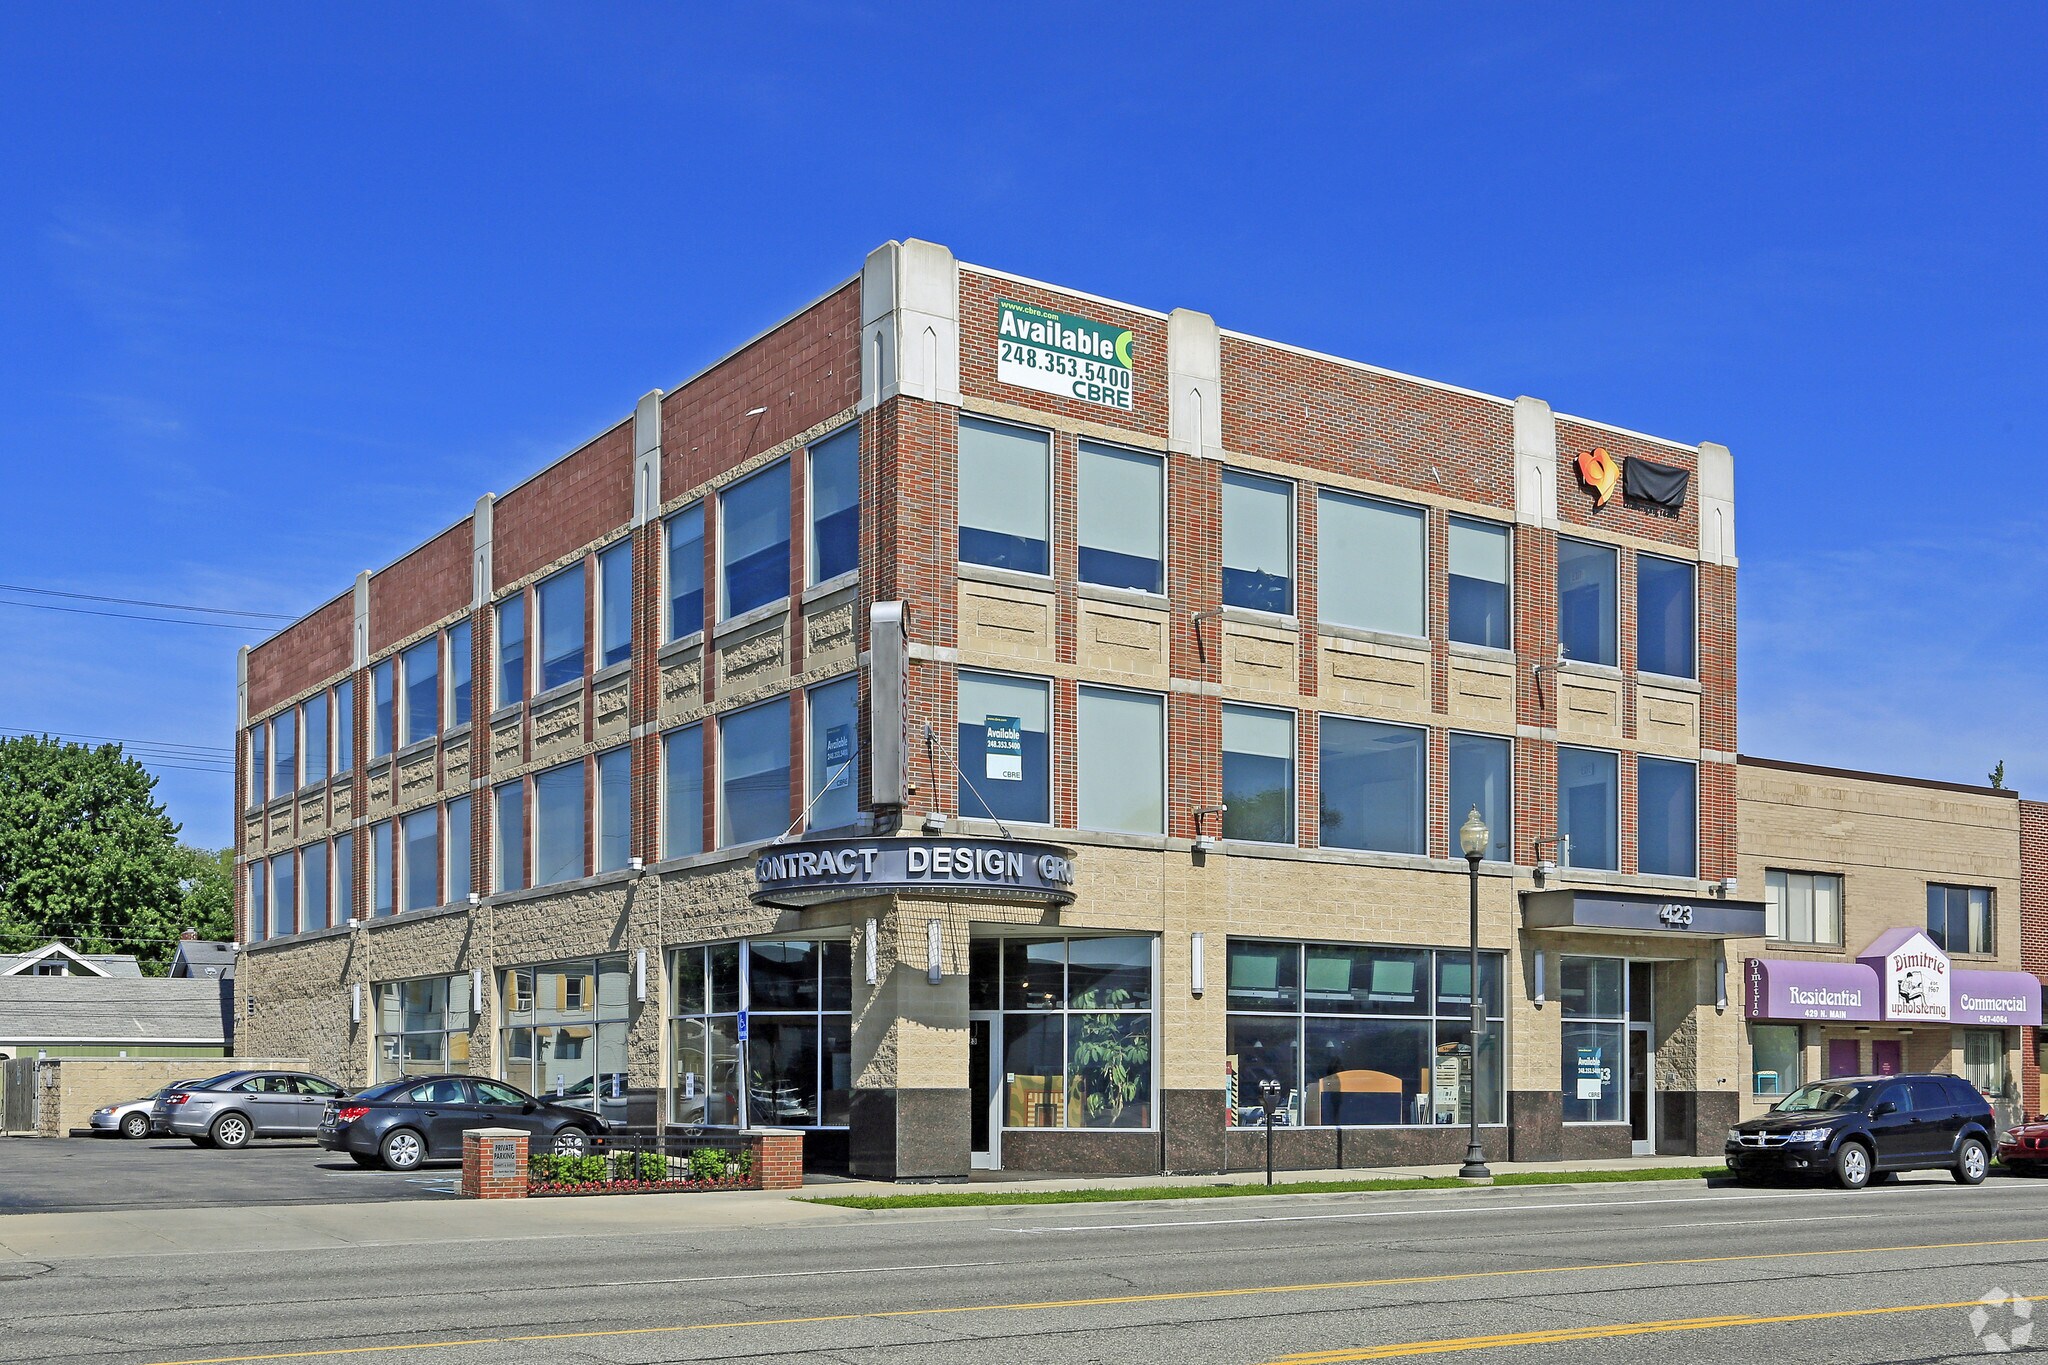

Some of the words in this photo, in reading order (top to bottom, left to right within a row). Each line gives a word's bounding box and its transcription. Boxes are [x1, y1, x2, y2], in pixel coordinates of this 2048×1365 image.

[1000, 301, 1059, 321] www.cbre.com
[1000, 310, 1114, 360] Available
[1001, 342, 1130, 390] 248.353.5400
[1072, 380, 1130, 409] CBRE
[827, 736, 848, 750] Available
[987, 726, 1020, 740] Available
[1002, 770, 1020, 779] CBRE
[908, 847, 1024, 877] DESIGN
[1660, 904, 1693, 925] 423
[1893, 952, 1945, 975] Dimitrie
[1750, 959, 1762, 1016] Dimitrie
[1789, 986, 1862, 1007] Residential
[1892, 1001, 1947, 1018] upholstering
[1960, 993, 2027, 1012] Commercial
[1804, 1009, 1818, 1018] 429
[1830, 1010, 1847, 1018] MAIN
[1578, 1056, 1600, 1066] Available
[494, 1152, 515, 1160] PARKING
